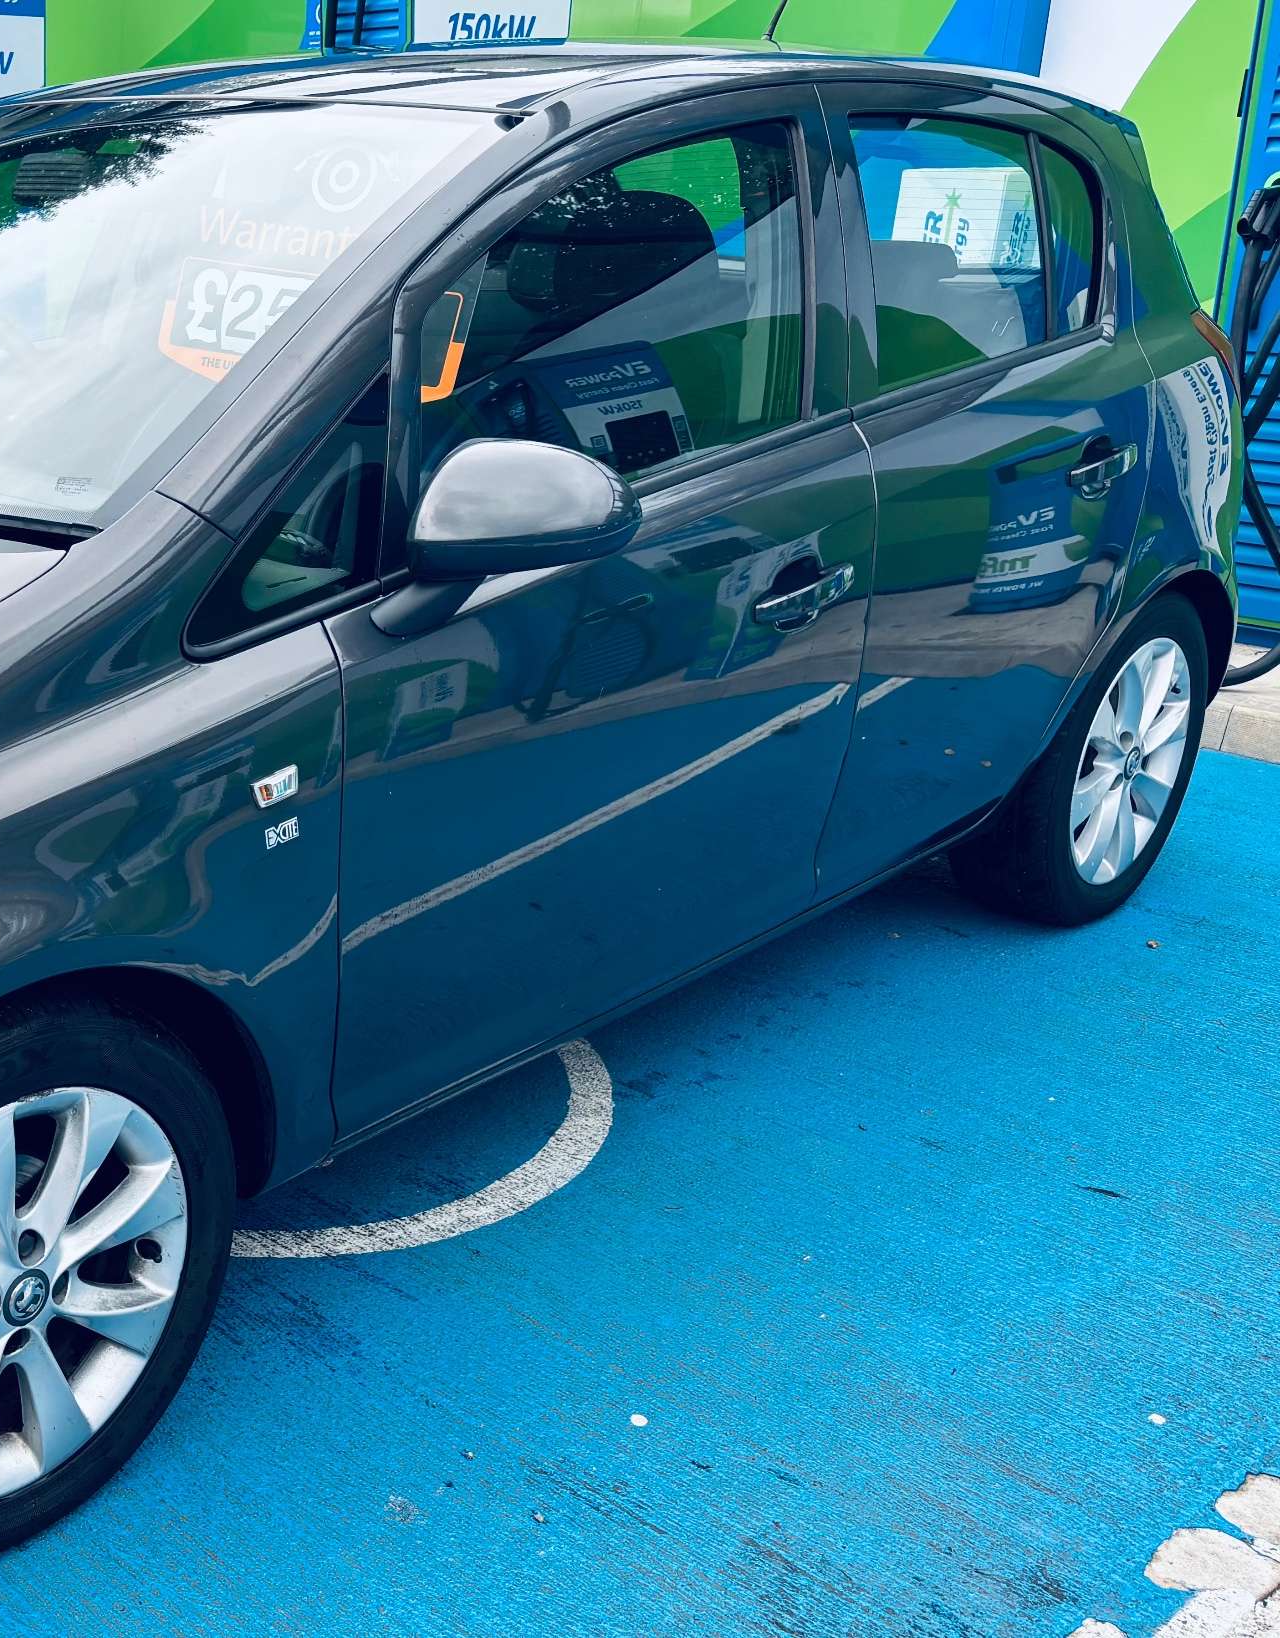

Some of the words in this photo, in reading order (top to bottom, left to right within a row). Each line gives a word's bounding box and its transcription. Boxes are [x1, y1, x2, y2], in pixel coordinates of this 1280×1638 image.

[448, 13, 536, 40] 150kW
[199, 204, 357, 259] Warrant
[200, 356, 224, 369] THE
